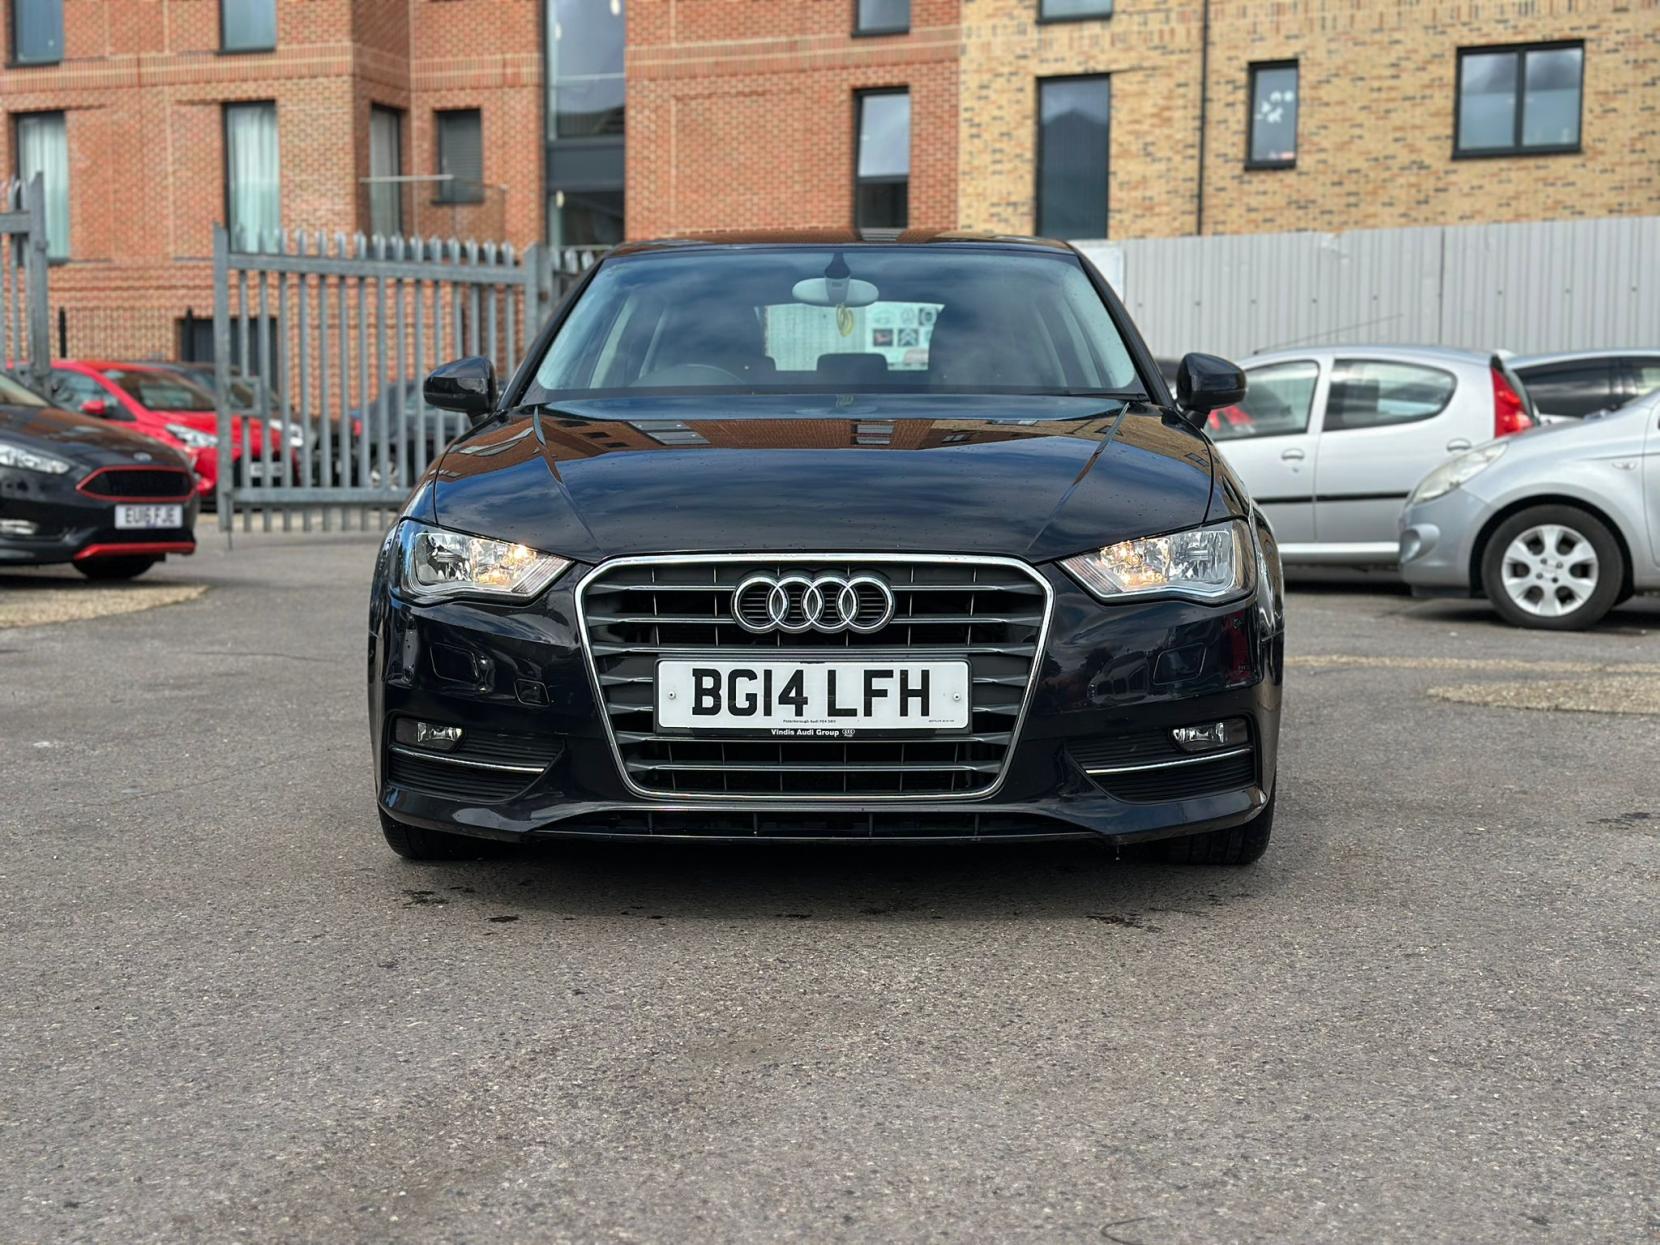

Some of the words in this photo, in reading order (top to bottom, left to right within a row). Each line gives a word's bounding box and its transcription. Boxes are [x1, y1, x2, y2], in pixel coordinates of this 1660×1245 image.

[692, 668, 808, 717] BG14
[827, 669, 930, 717] LFH
[816, 729, 840, 738] Group
